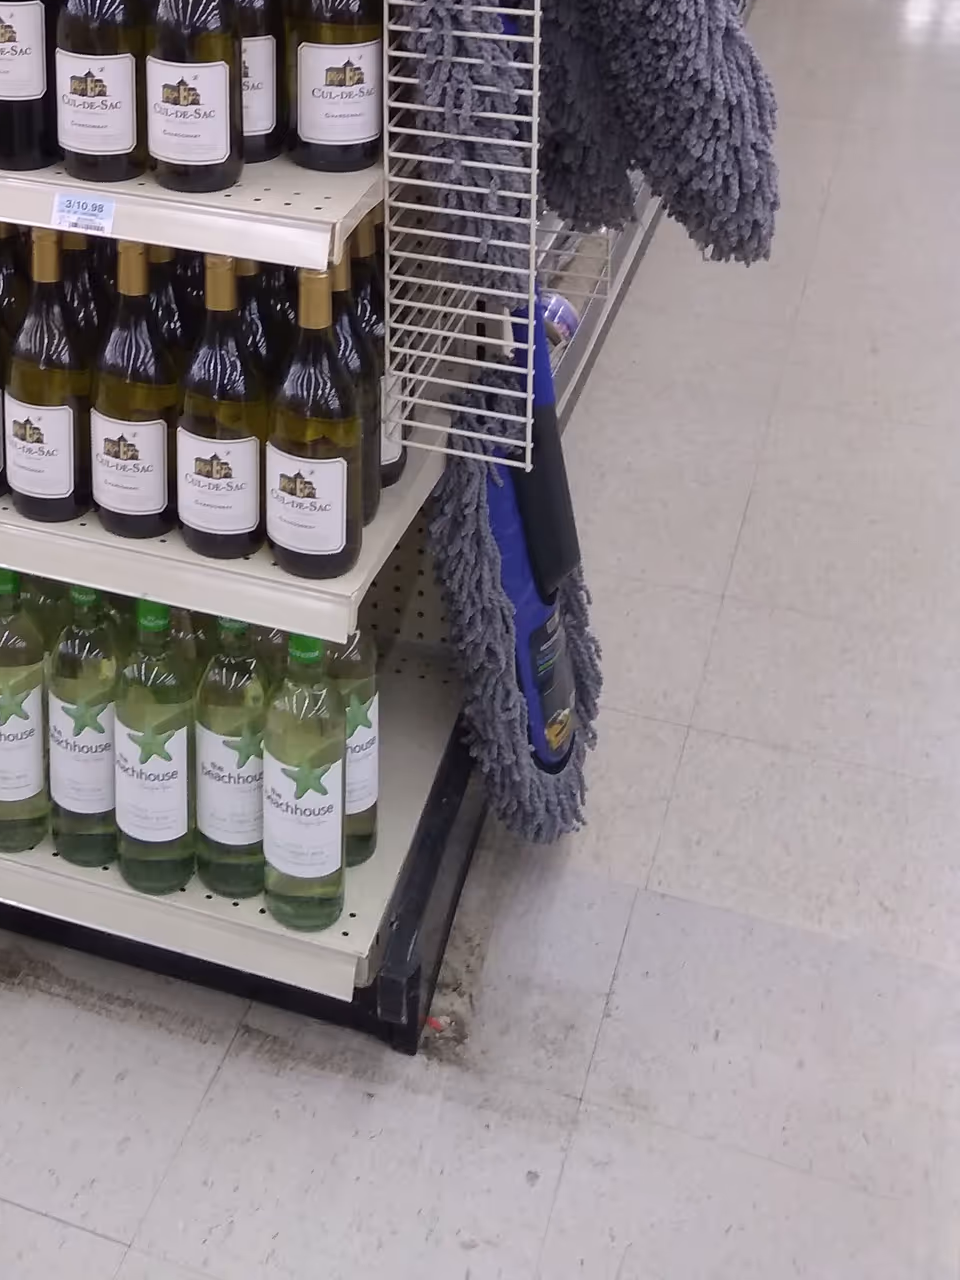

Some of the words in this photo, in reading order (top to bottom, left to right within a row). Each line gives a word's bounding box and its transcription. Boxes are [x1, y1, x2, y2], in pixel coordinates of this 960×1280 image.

[61, 95, 122, 110] CUL-DE-SAC
[152, 103, 216, 119] CUL-DE-SAC
[65, 200, 104, 213] 3/10.98
[95, 454, 154, 472] CUL-DE-SAC
[185, 473, 247, 492] CUL-DE-SAC
[270, 487, 331, 512] CUL-DE-SAC
[210, 762, 224, 772] the
[270, 786, 283, 799] the
